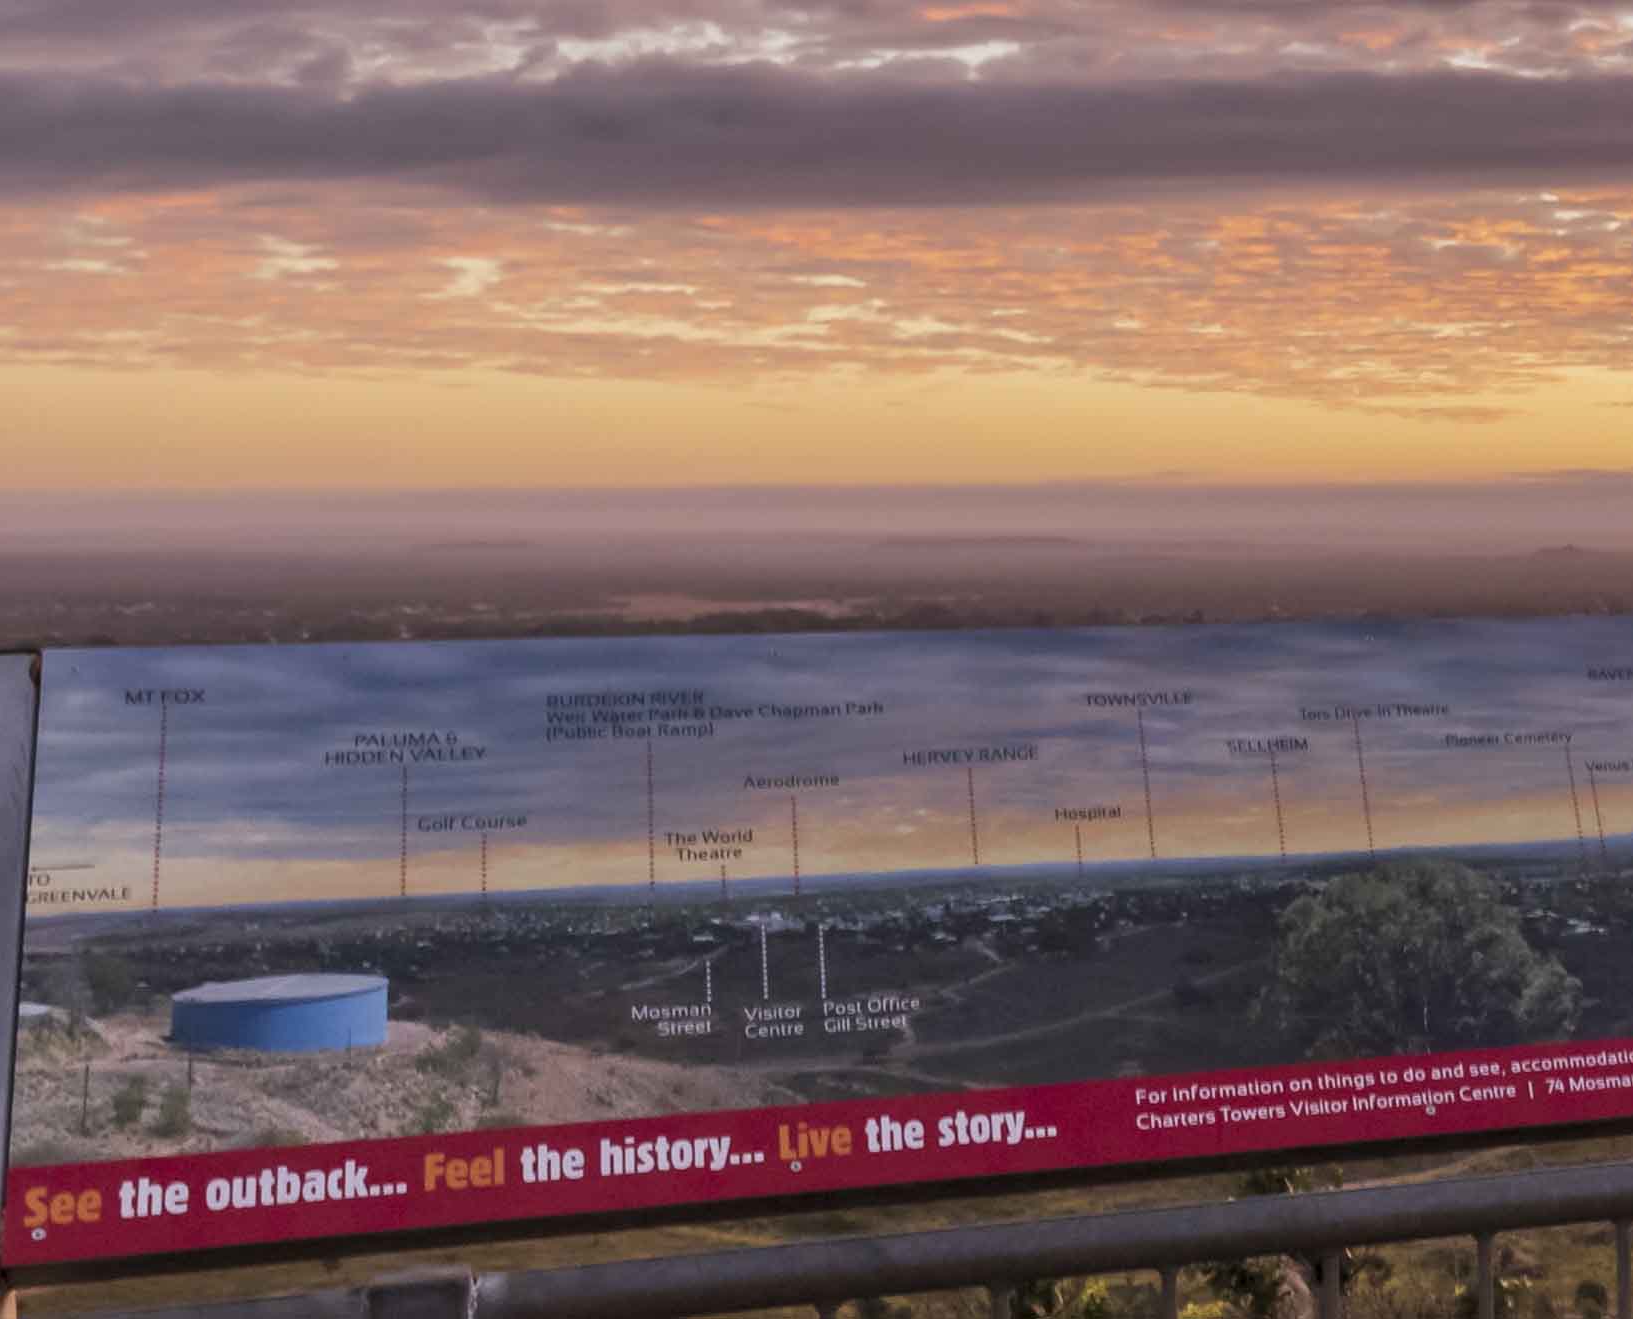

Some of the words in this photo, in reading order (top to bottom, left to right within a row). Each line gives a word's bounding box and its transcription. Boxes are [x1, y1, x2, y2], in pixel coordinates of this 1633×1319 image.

[124, 689, 154, 705] MT
[159, 688, 206, 704] FOX
[651, 690, 704, 705] RIVER
[1086, 691, 1193, 708] TOWNSVILLE
[710, 704, 753, 719] Dave
[758, 701, 841, 720] Chapman
[845, 701, 884, 716] Park
[354, 731, 438, 748] PALUMA
[1226, 735, 1310, 753] SELLHEIM
[324, 750, 405, 766] HIDDEN
[411, 746, 486, 762] VALLEY
[902, 748, 975, 766] HERVEY
[979, 745, 1039, 762] RANGE
[743, 773, 840, 790] Aerodrome
[1054, 805, 1121, 822] Hospital
[418, 815, 456, 833] Golf
[461, 814, 528, 831] Course
[664, 831, 697, 847] The
[702, 828, 754, 845] World
[676, 847, 743, 863] Theatre
[631, 1001, 712, 1020] Mosman
[744, 1005, 803, 1022] Visitor
[822, 1000, 863, 1017] Post
[867, 995, 921, 1013] Office
[657, 1020, 712, 1037] Street
[744, 1022, 805, 1040] Centre
[823, 1016, 851, 1034] Gill
[855, 1013, 908, 1031] Street
[1135, 1087, 1168, 1106] For
[1172, 1075, 1285, 1103] information
[1289, 1077, 1313, 1093] on
[1317, 1068, 1375, 1092] things
[1379, 1067, 1399, 1085] to
[1403, 1064, 1427, 1083] do
[1430, 1061, 1465, 1080] and
[1469, 1061, 1507, 1079] see,
[1135, 1105, 1215, 1131] Charters
[1219, 1100, 1286, 1124] Towers
[1289, 1095, 1350, 1118] Visitor
[1353, 1085, 1456, 1112] Information
[1459, 1082, 1518, 1103] Centre
[1545, 1078, 1565, 1095] 74
[22, 1186, 102, 1228] See
[118, 1176, 189, 1220] the
[205, 1159, 409, 1212] outback...
[424, 1146, 506, 1192] Feel
[519, 1144, 586, 1184] the
[599, 1134, 766, 1178] history...
[778, 1121, 853, 1161] Live
[865, 1114, 926, 1154] the
[937, 1109, 1059, 1148] story...
